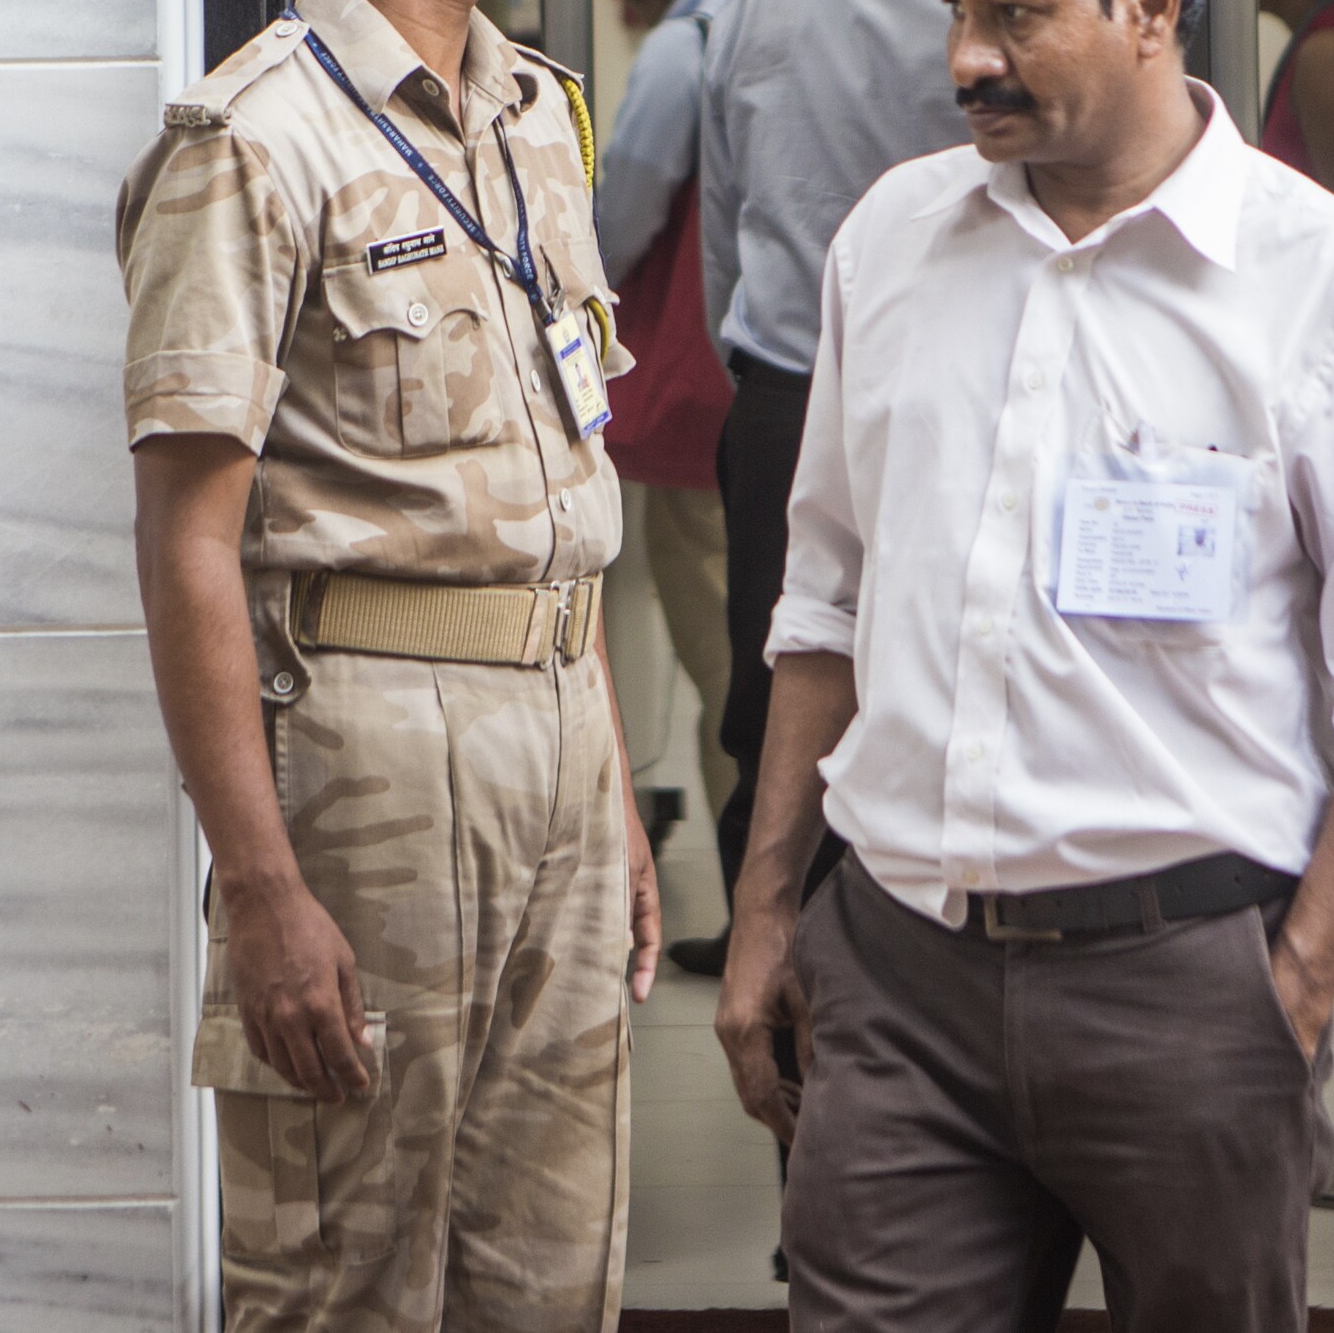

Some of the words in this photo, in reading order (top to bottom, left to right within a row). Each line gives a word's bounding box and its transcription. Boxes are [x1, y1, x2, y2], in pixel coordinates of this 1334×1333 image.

[426, 174, 450, 200] FORCE
[446, 196, 478, 233] SECURITY
[521, 251, 534, 280] FORCE
